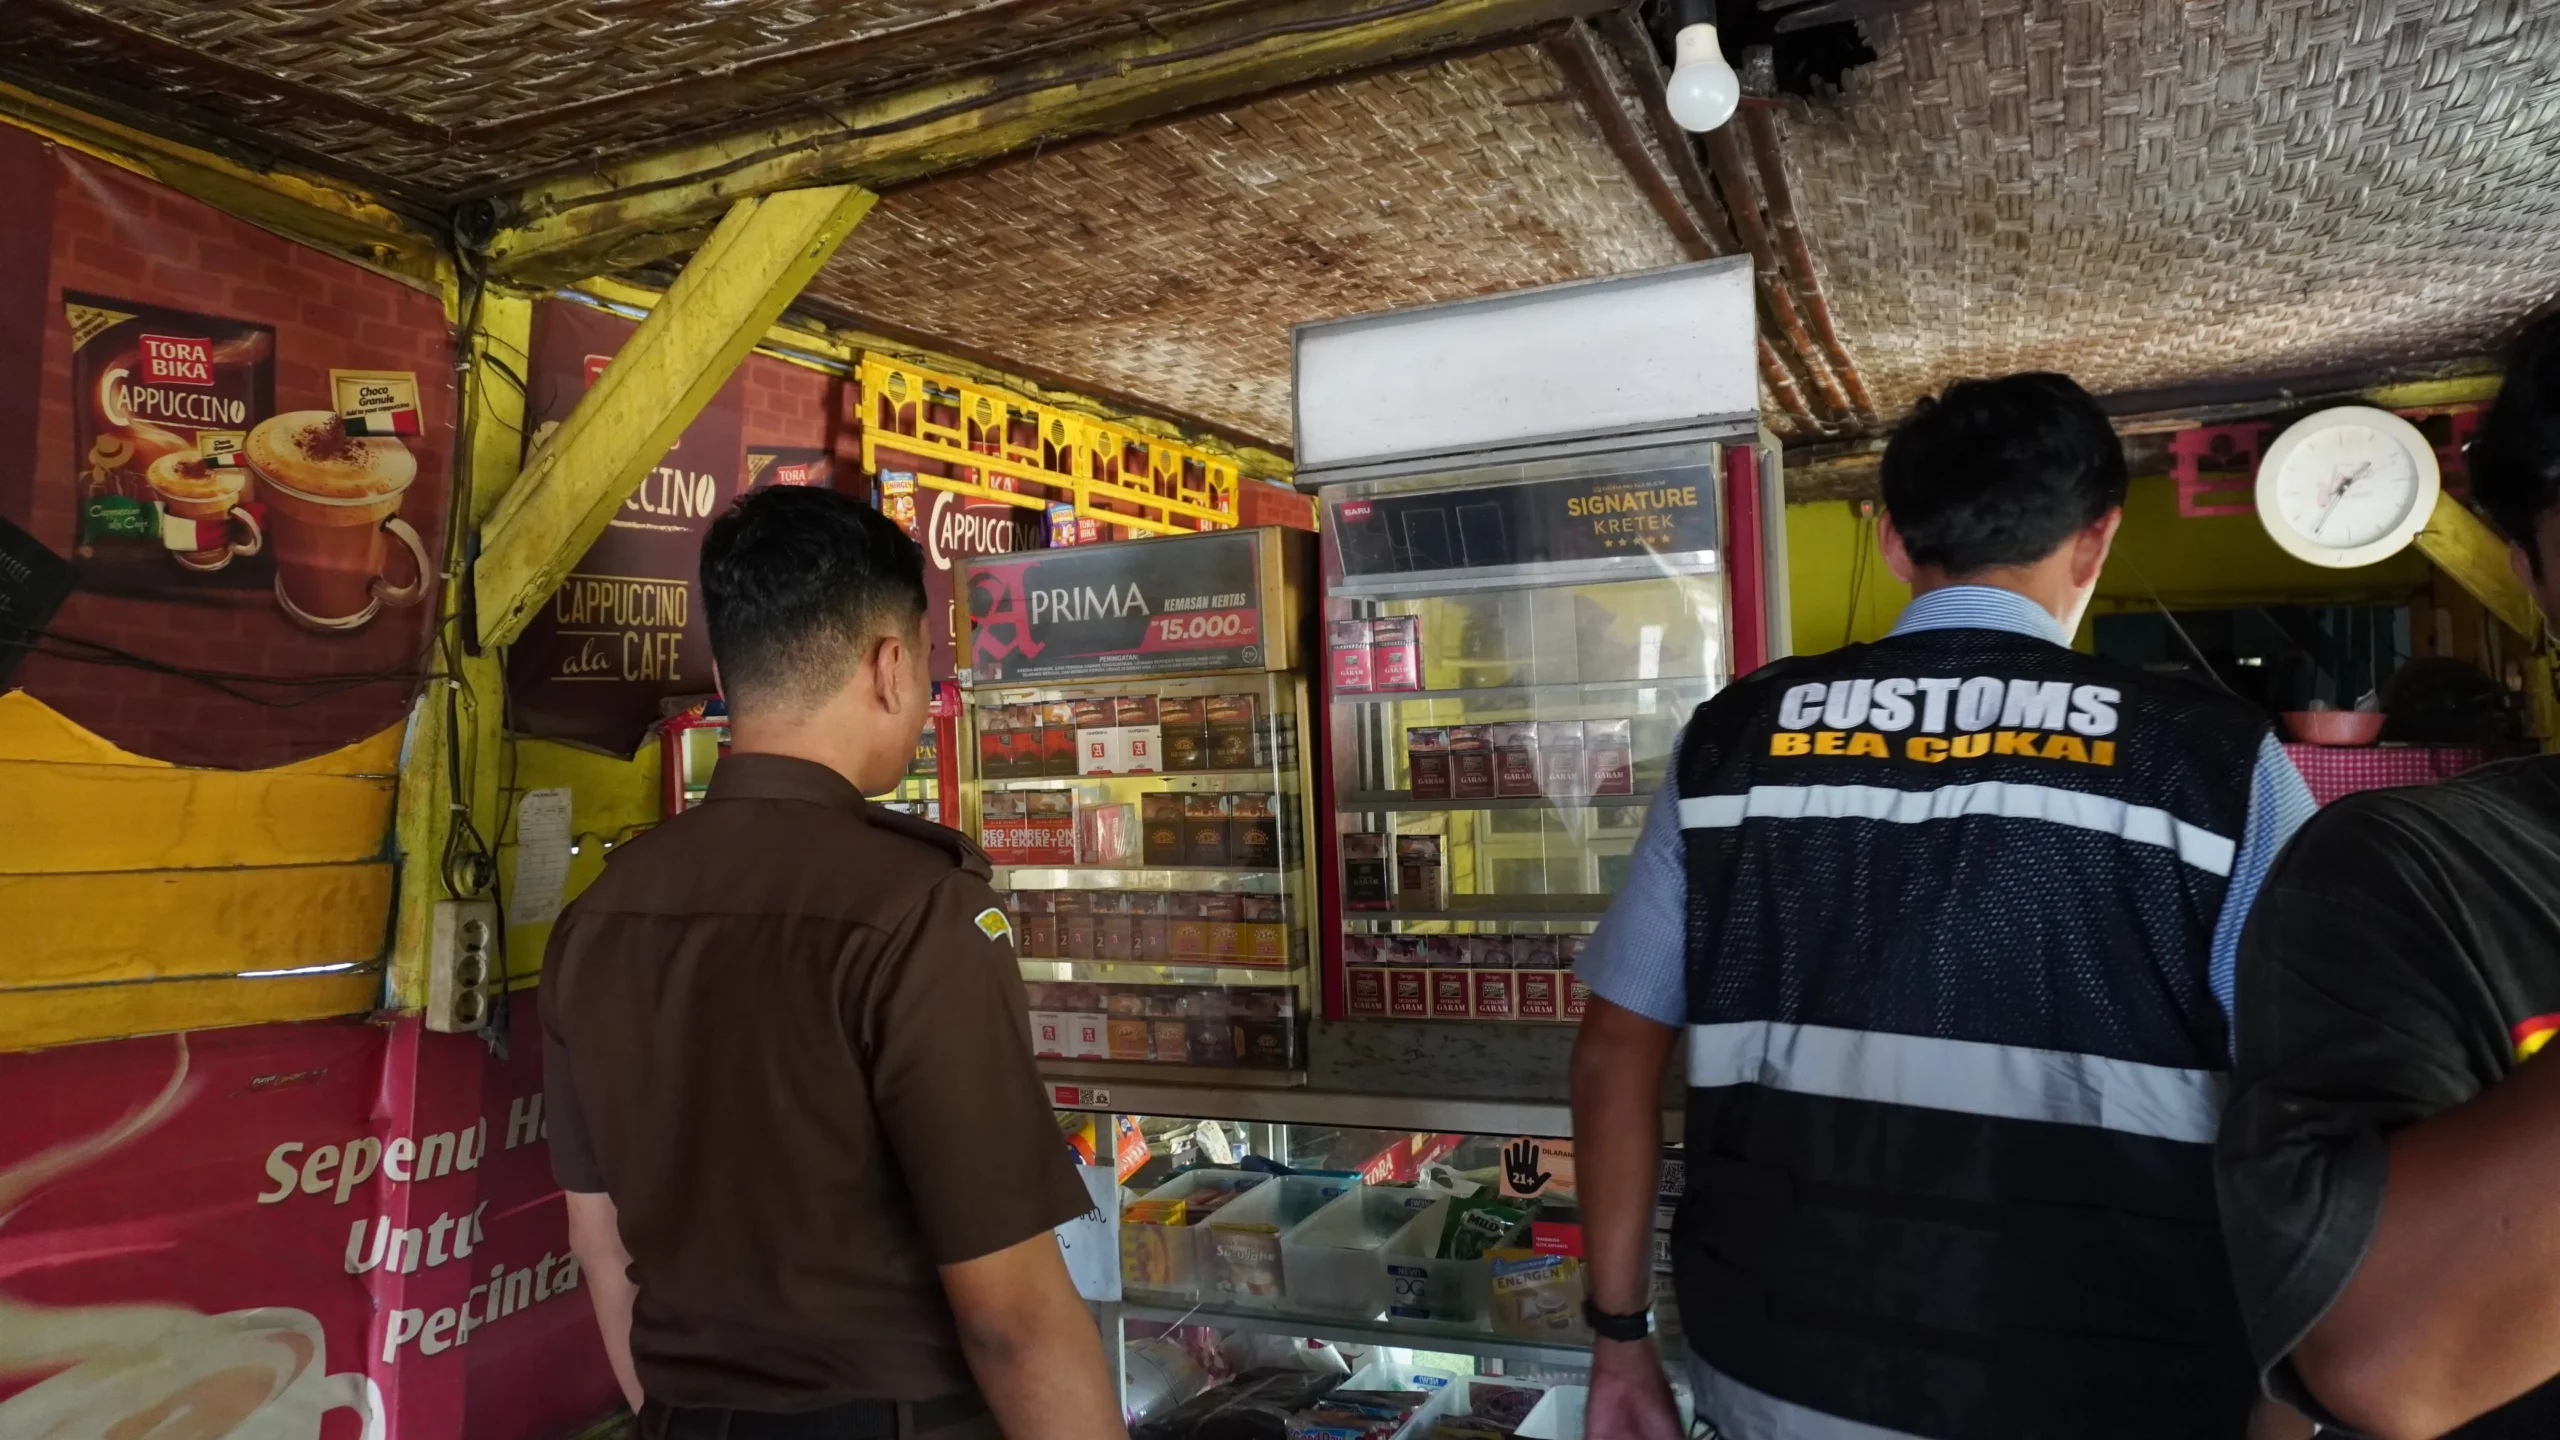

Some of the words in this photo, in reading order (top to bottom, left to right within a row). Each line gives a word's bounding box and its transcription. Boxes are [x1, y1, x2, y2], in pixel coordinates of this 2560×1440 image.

[145, 340, 207, 362] TORA
[151, 359, 208, 379] BIKA
[101, 368, 246, 426] CAPPUCCINO
[360, 386, 389, 397] Choco
[358, 394, 394, 407] Granule
[779, 469, 806, 482] TORA
[1567, 486, 1698, 517] SIGNATURE
[1344, 505, 1371, 517] BARU
[1594, 513, 1675, 535] KRETEK
[556, 580, 687, 627] CAPPUCCINO
[1031, 582, 1150, 625] PRIMA
[1163, 596, 1209, 612] KEMASAN
[1211, 593, 1247, 608] KERTAS
[562, 637, 611, 674] ala
[623, 631, 682, 681] CAFE
[1777, 676, 2121, 736] CUSTOMS
[1769, 731, 1890, 758] BEA
[1905, 731, 2116, 767] CUKAI
[1460, 776, 1488, 784] GARAM
[1549, 772, 1577, 780] GARAM
[1594, 771, 1624, 779] GARAM
[1394, 1003, 1423, 1011] GARAM
[1437, 1003, 1465, 1011] GARAM
[1479, 1004, 1509, 1012] GARAM
[1522, 1005, 1553, 1013] GARAM
[1542, 1147, 1575, 1158] DILARAN
[1365, 1152, 1394, 1186] TORA
[1512, 1172, 1535, 1186] 21+
[1467, 1213, 1499, 1232] MILO
[1398, 1266, 1421, 1277] NEW!
[1497, 1268, 1560, 1289] ENERGEN
